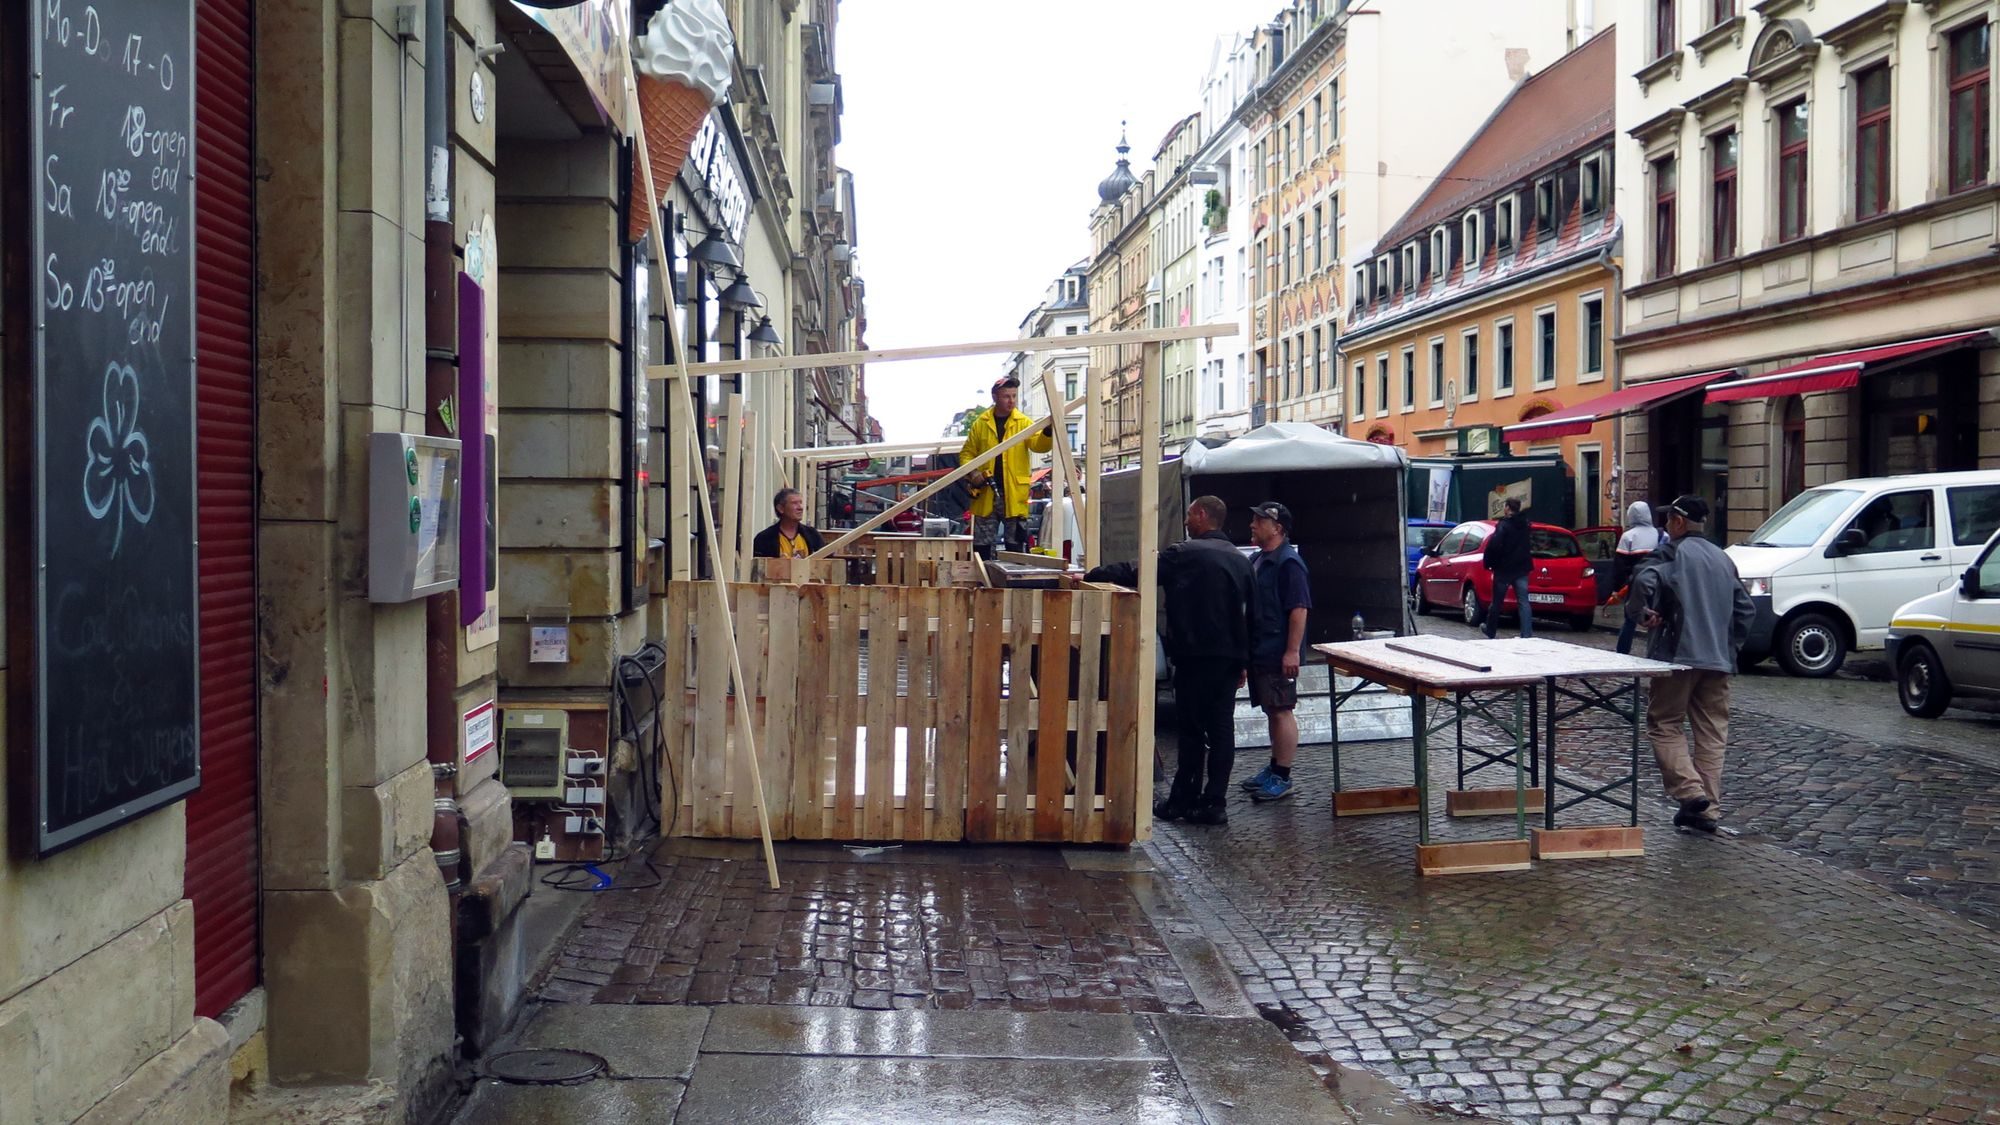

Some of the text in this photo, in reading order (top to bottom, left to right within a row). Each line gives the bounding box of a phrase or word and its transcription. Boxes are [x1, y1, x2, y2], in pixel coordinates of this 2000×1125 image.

[48, 84, 75, 129] Fr
[46, 153, 74, 219] Sa
[151, 160, 181, 194] end
[141, 216, 174, 256] end
[46, 252, 75, 311] So
[128, 294, 170, 345] end
